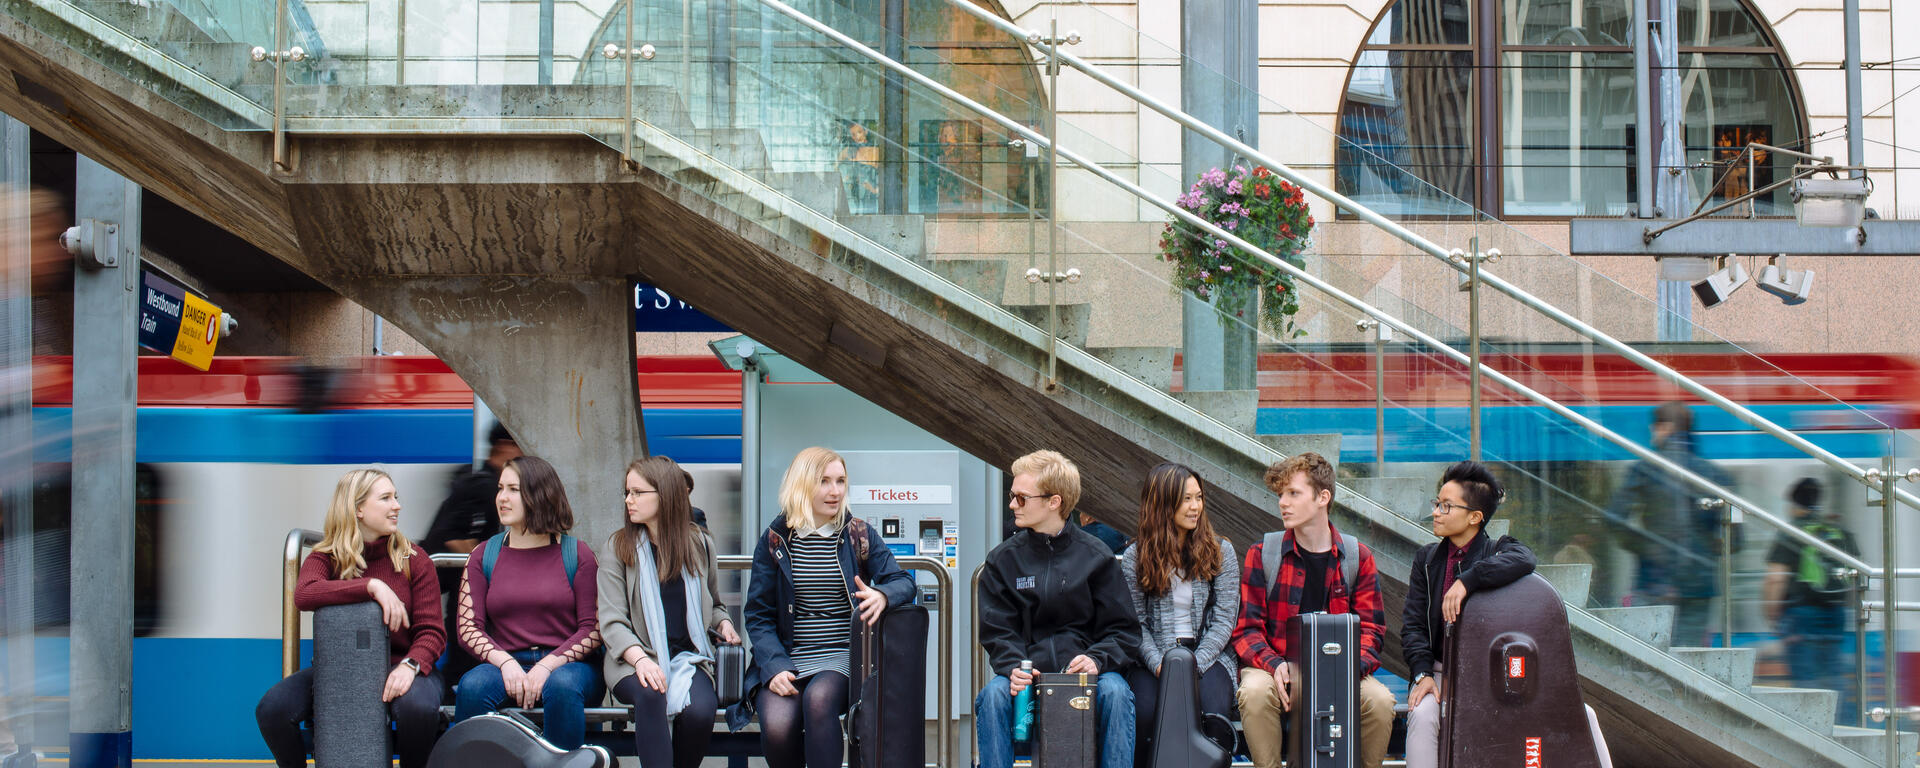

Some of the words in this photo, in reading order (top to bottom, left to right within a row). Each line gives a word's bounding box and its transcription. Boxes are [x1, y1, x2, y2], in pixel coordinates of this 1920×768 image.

[147, 288, 180, 317] Westbound
[141, 312, 157, 333] Train
[185, 304, 206, 326] DANGER
[868, 489, 919, 501] Tickets
